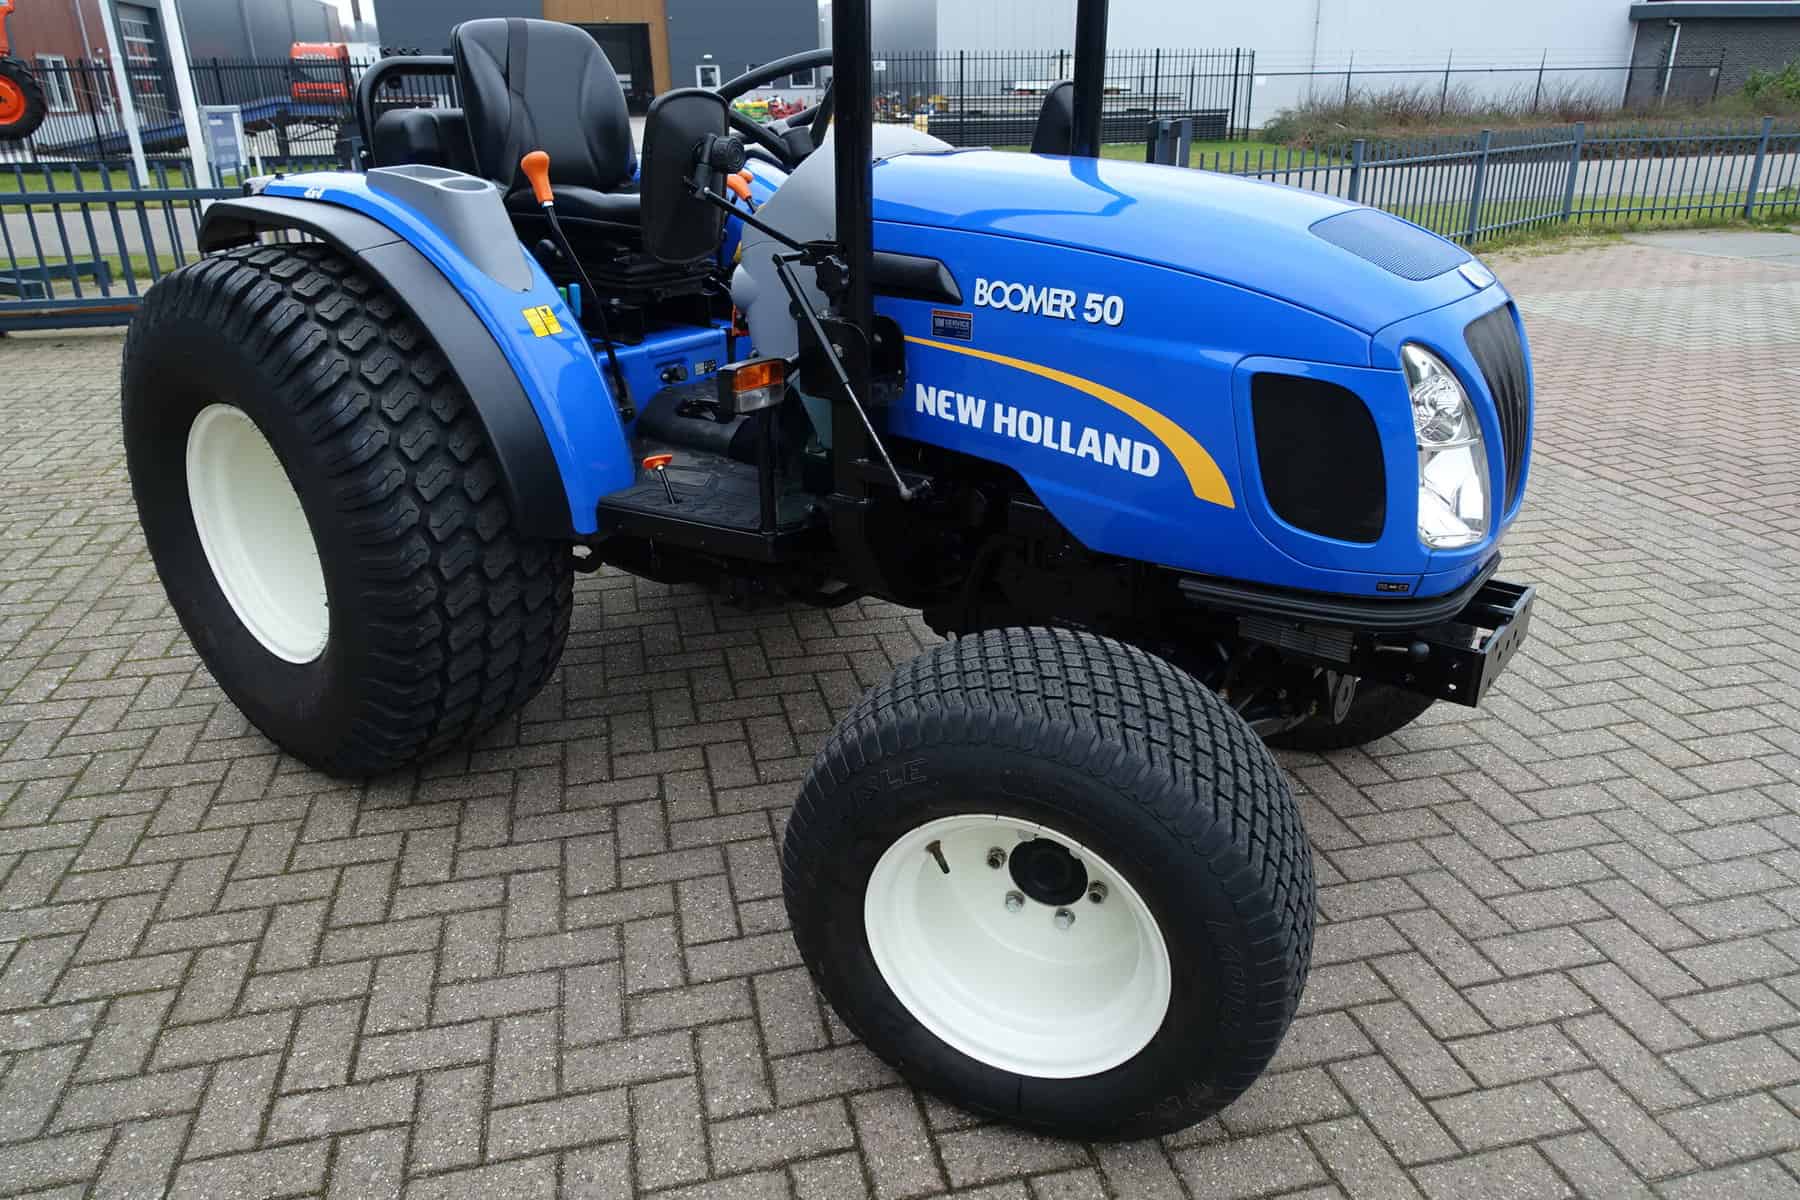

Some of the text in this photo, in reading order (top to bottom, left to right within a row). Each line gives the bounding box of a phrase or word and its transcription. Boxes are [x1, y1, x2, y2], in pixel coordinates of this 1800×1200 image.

[974, 278, 1124, 326] BOOMER 50
[915, 383, 1160, 478] NEW HOLLAND
